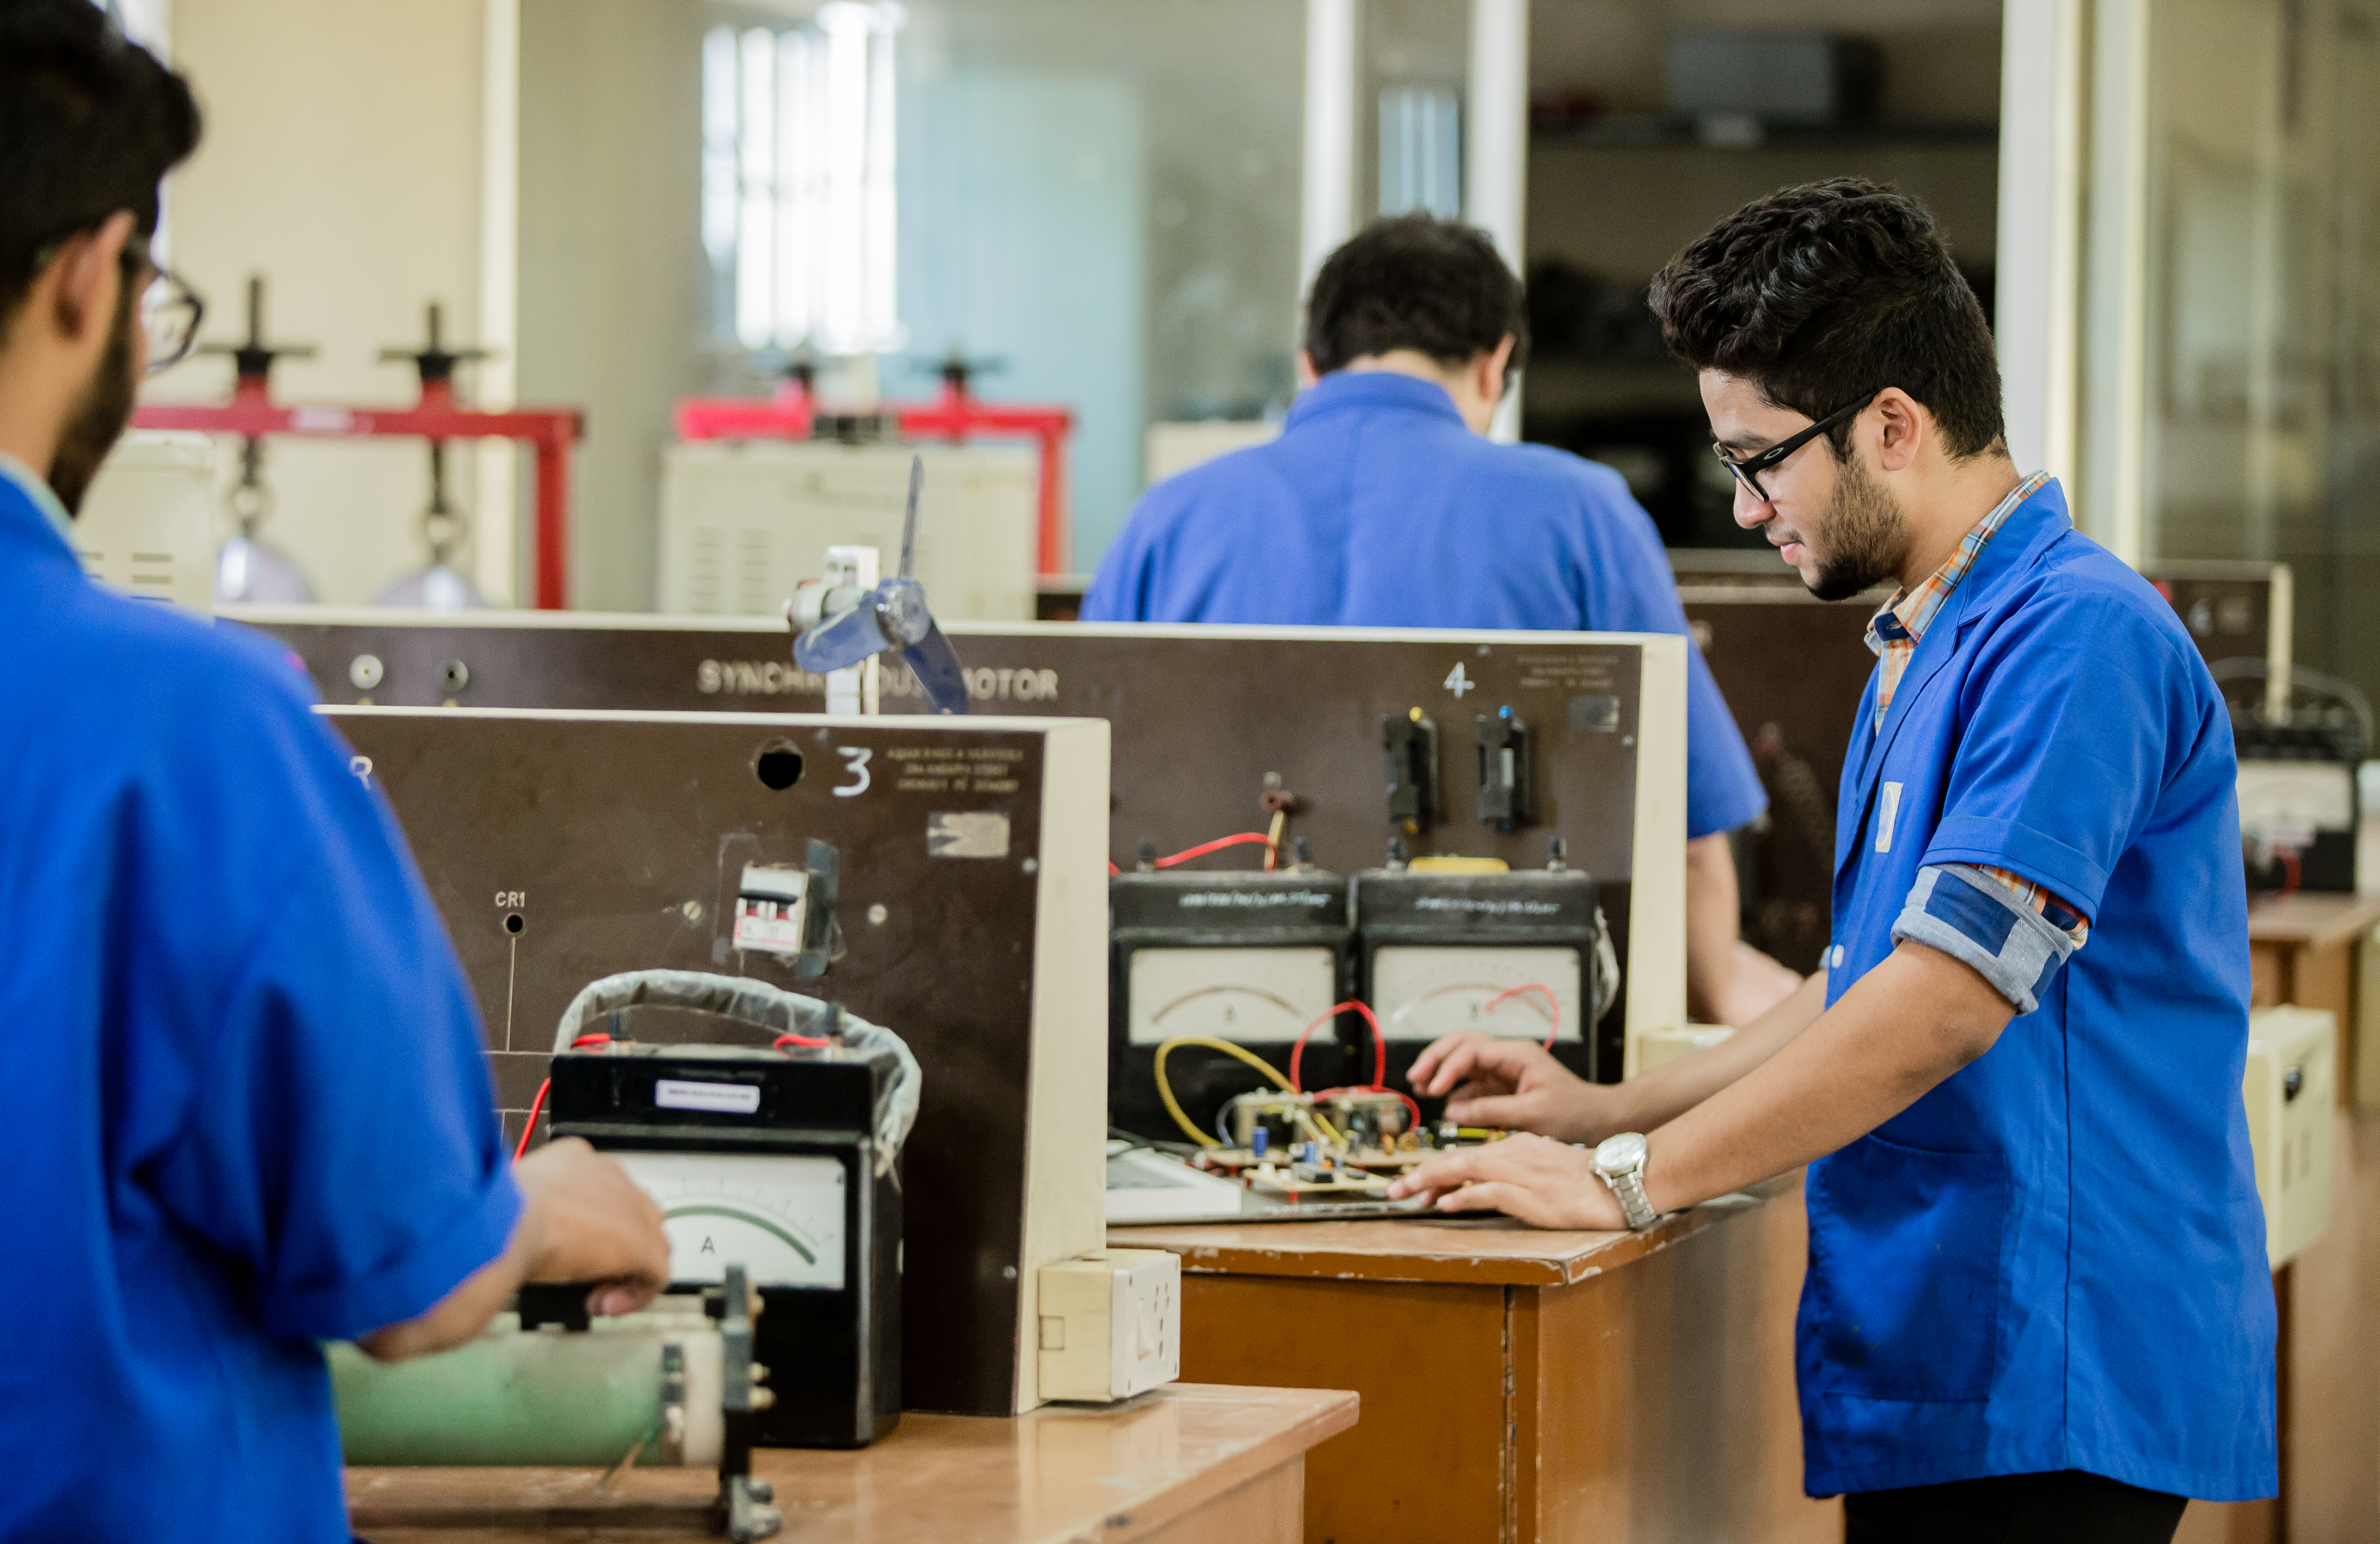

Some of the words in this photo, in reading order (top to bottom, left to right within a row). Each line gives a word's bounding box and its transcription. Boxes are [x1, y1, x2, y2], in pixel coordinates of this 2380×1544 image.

[1442, 661, 1475, 698] 4
[832, 746, 872, 797] 3
[495, 891, 525, 908] CR1
[701, 1235, 715, 1254] A
